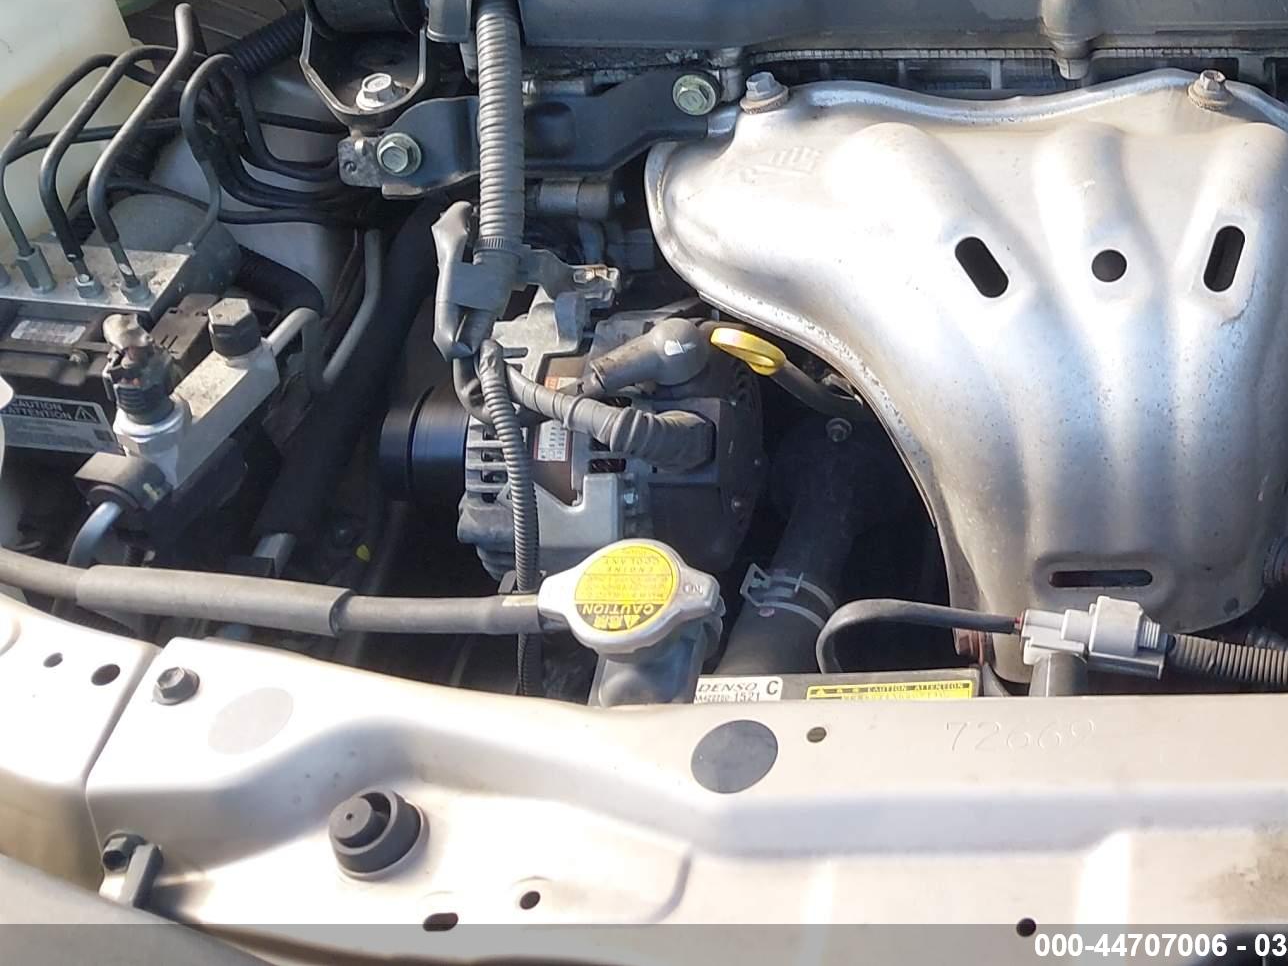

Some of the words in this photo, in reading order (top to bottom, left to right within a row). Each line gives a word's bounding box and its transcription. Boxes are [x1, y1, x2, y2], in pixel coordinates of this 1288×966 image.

[12, 400, 62, 411] CAUTION
[8, 406, 73, 420] ATTENTION
[582, 604, 654, 615] CAUTION
[698, 682, 758, 693] DENSO
[766, 680, 779, 695] C
